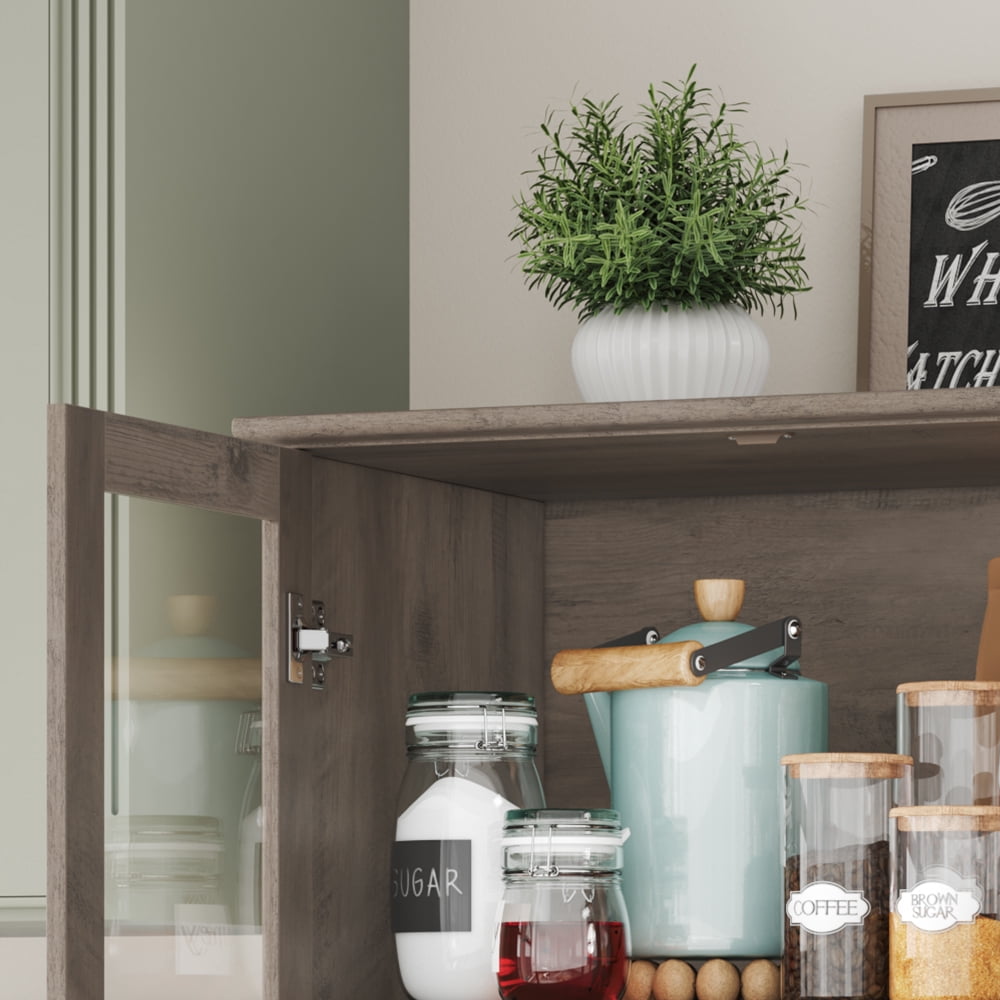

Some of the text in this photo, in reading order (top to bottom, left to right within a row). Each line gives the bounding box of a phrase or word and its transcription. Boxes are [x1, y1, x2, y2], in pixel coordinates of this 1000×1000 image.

[794, 899, 858, 916] COFFEE
[910, 893, 959, 907] BROWN
[911, 905, 959, 921] SUGAR
